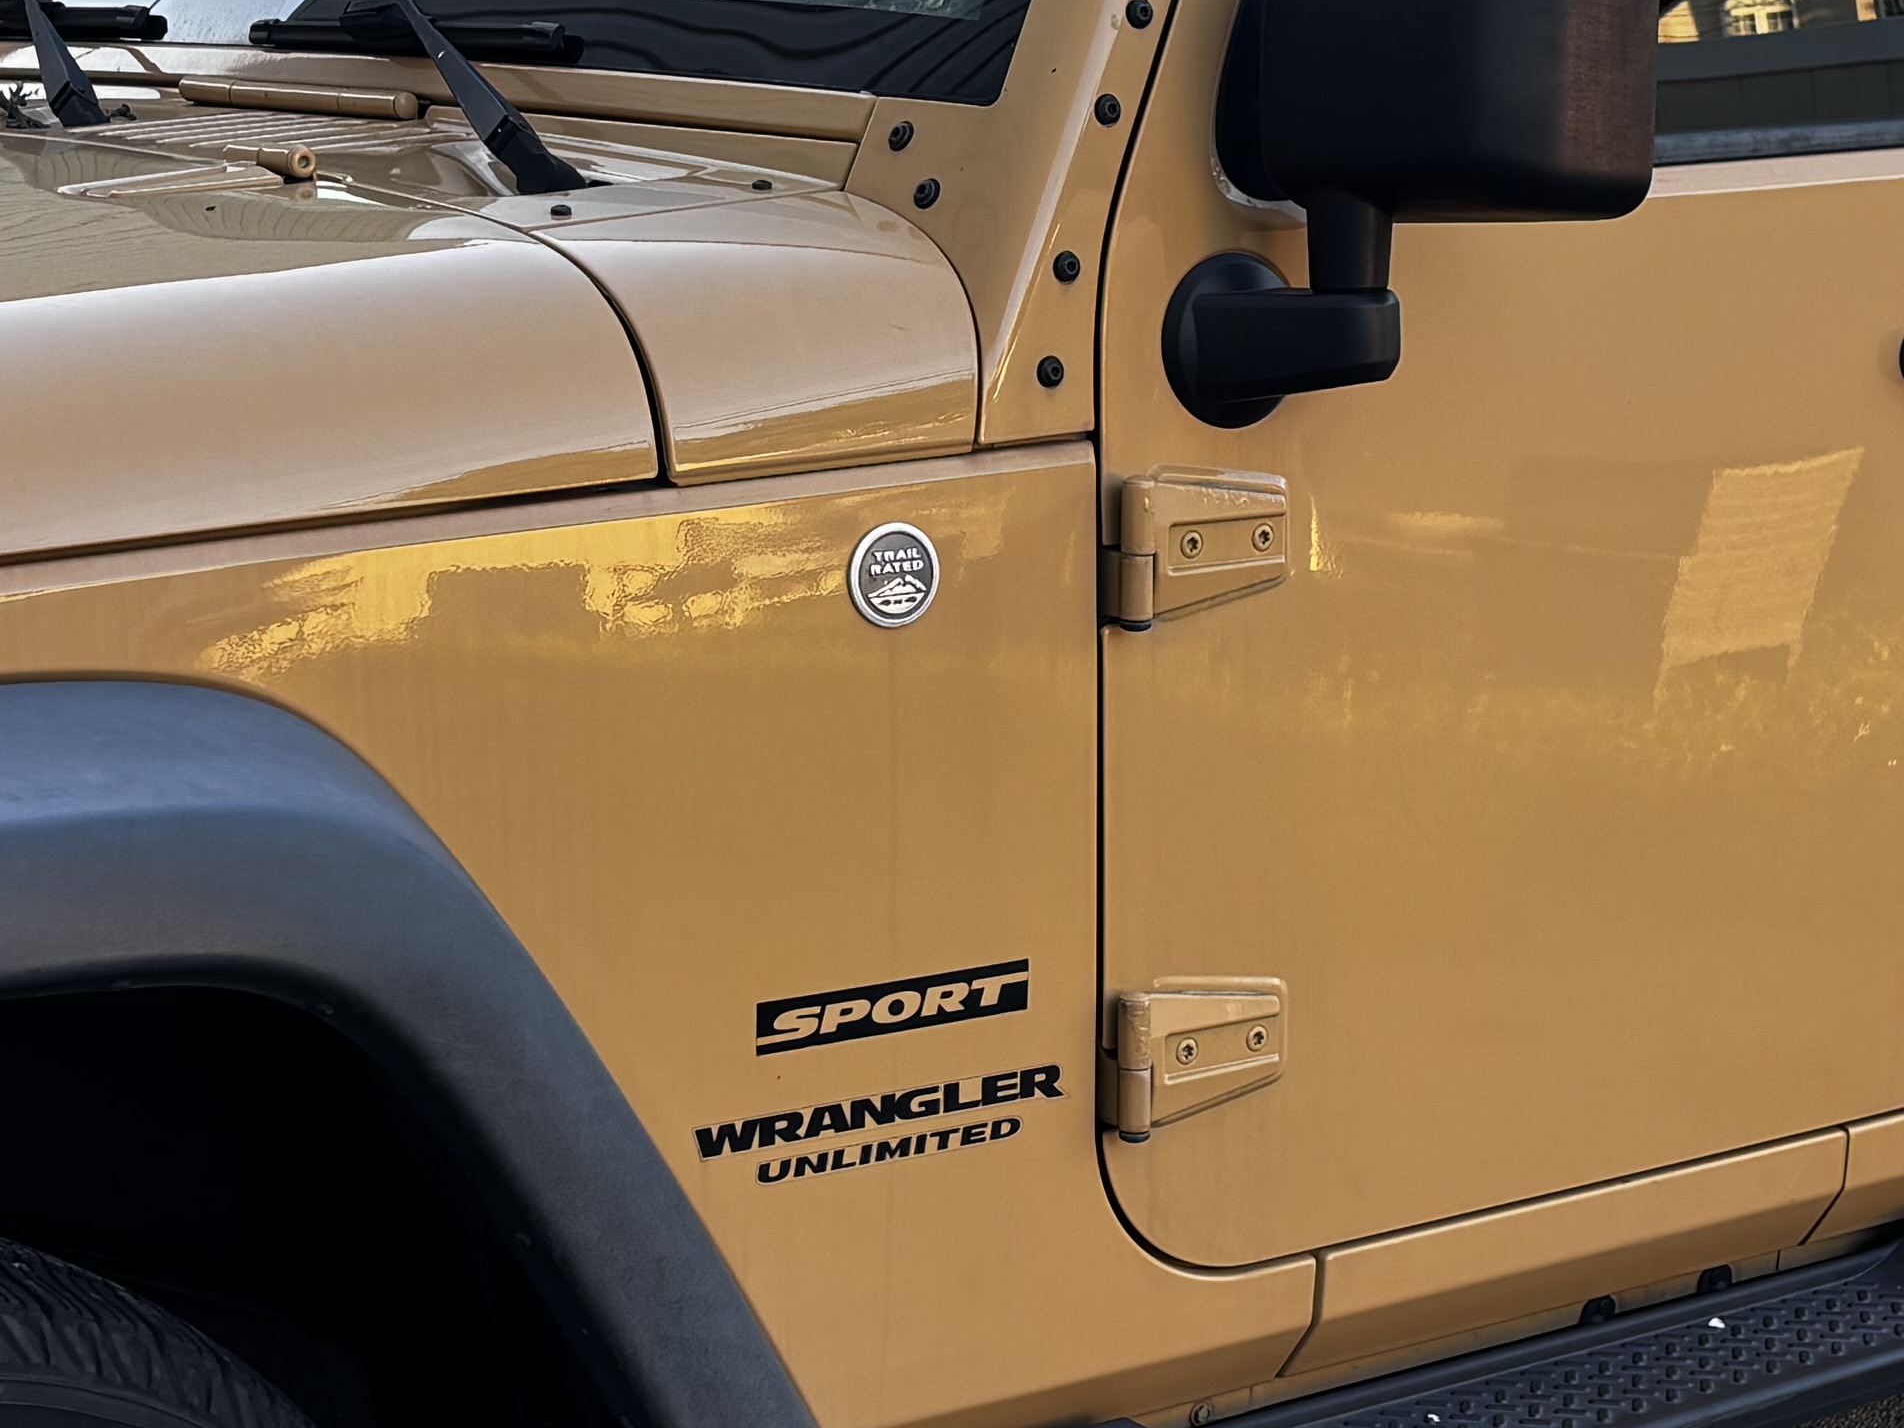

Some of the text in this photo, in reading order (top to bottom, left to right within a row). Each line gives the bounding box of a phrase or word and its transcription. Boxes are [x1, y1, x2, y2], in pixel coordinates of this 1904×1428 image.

[870, 560, 924, 576] RATED
[873, 548, 921, 562] TRAIL
[768, 970, 1028, 1043] SPORT
[696, 1065, 1065, 1159] WRANGLER
[757, 1118, 1022, 1184] UNLIMITED
